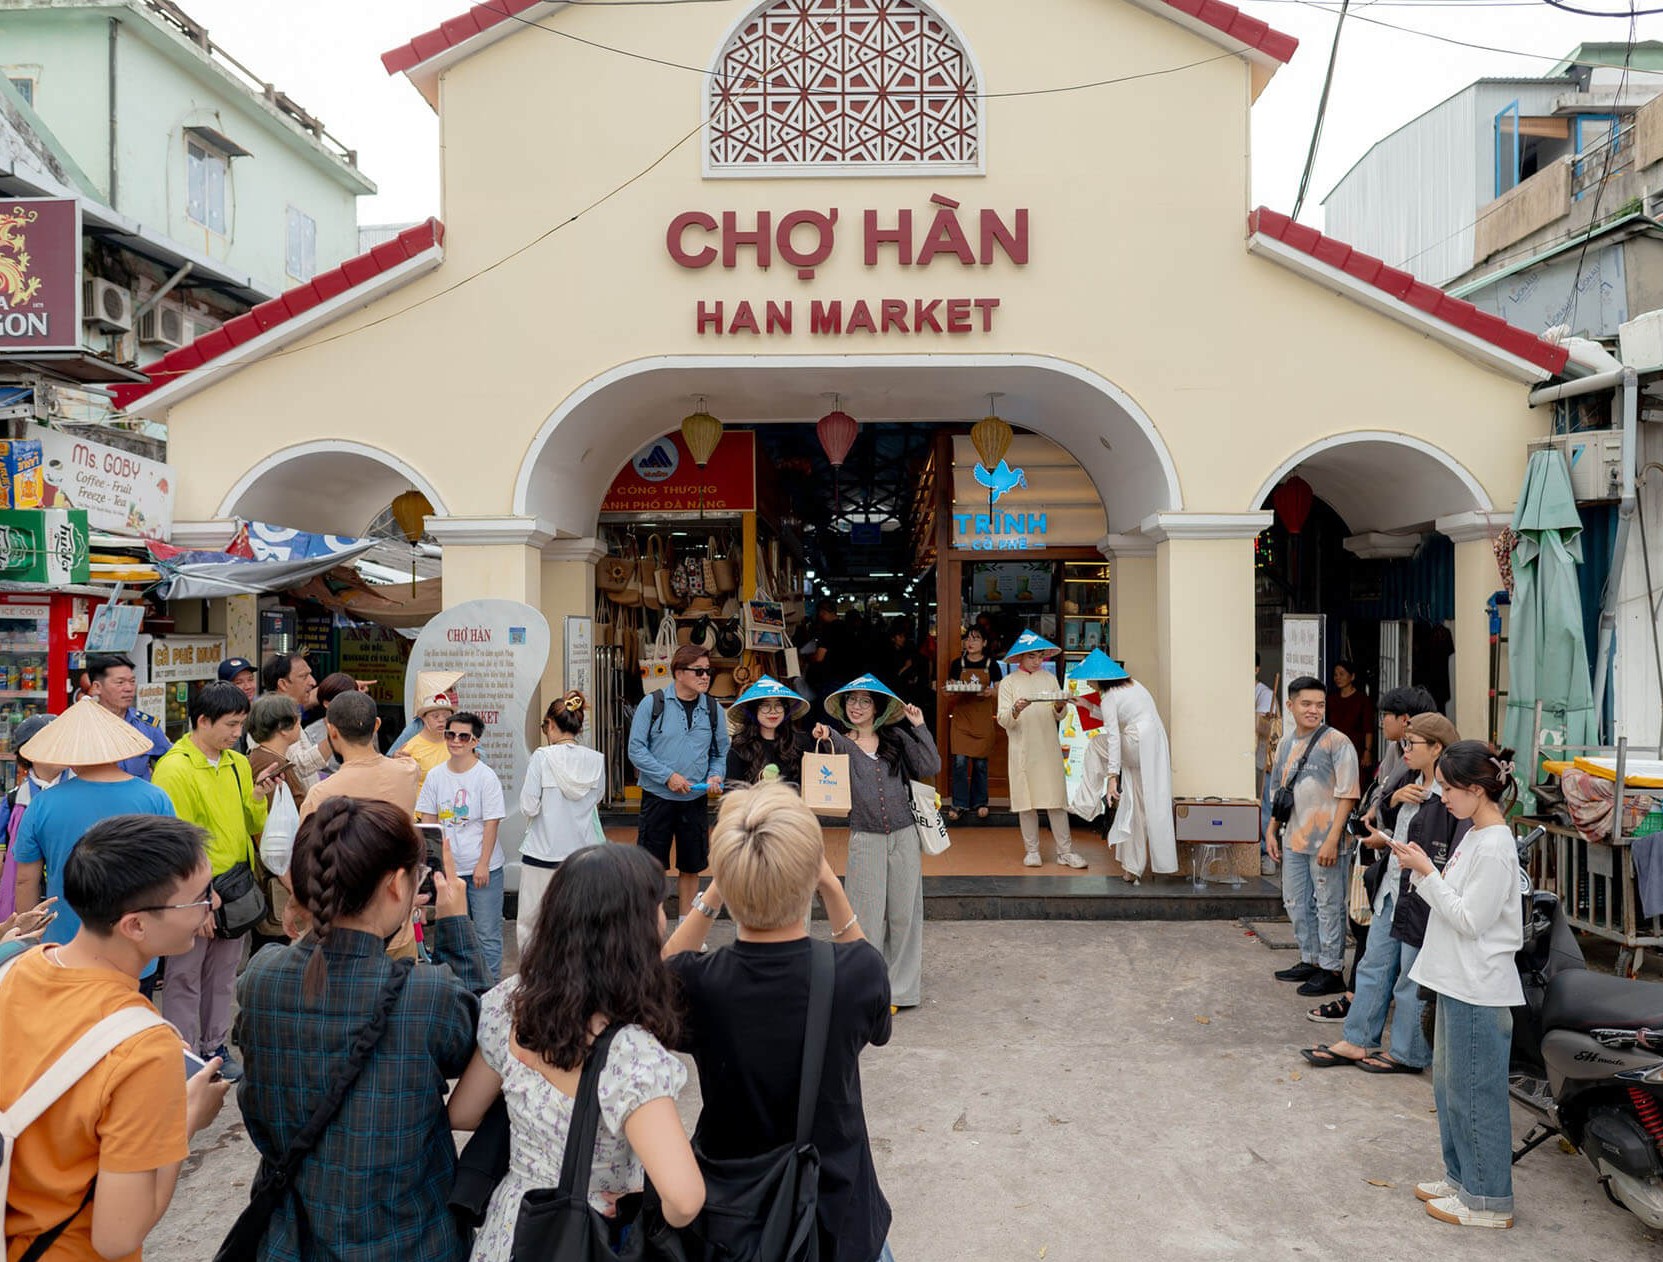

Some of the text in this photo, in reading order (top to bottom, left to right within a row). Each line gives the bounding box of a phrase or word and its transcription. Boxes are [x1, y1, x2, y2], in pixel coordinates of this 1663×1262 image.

[666, 193, 1029, 280] CHỢ HÀN
[697, 299, 1000, 334] HAN MARKET
[103, 453, 141, 480] GOBY
[76, 470, 105, 488] Coffee
[20, 608, 44, 616] COLD
[447, 627, 468, 644] CHỢ
